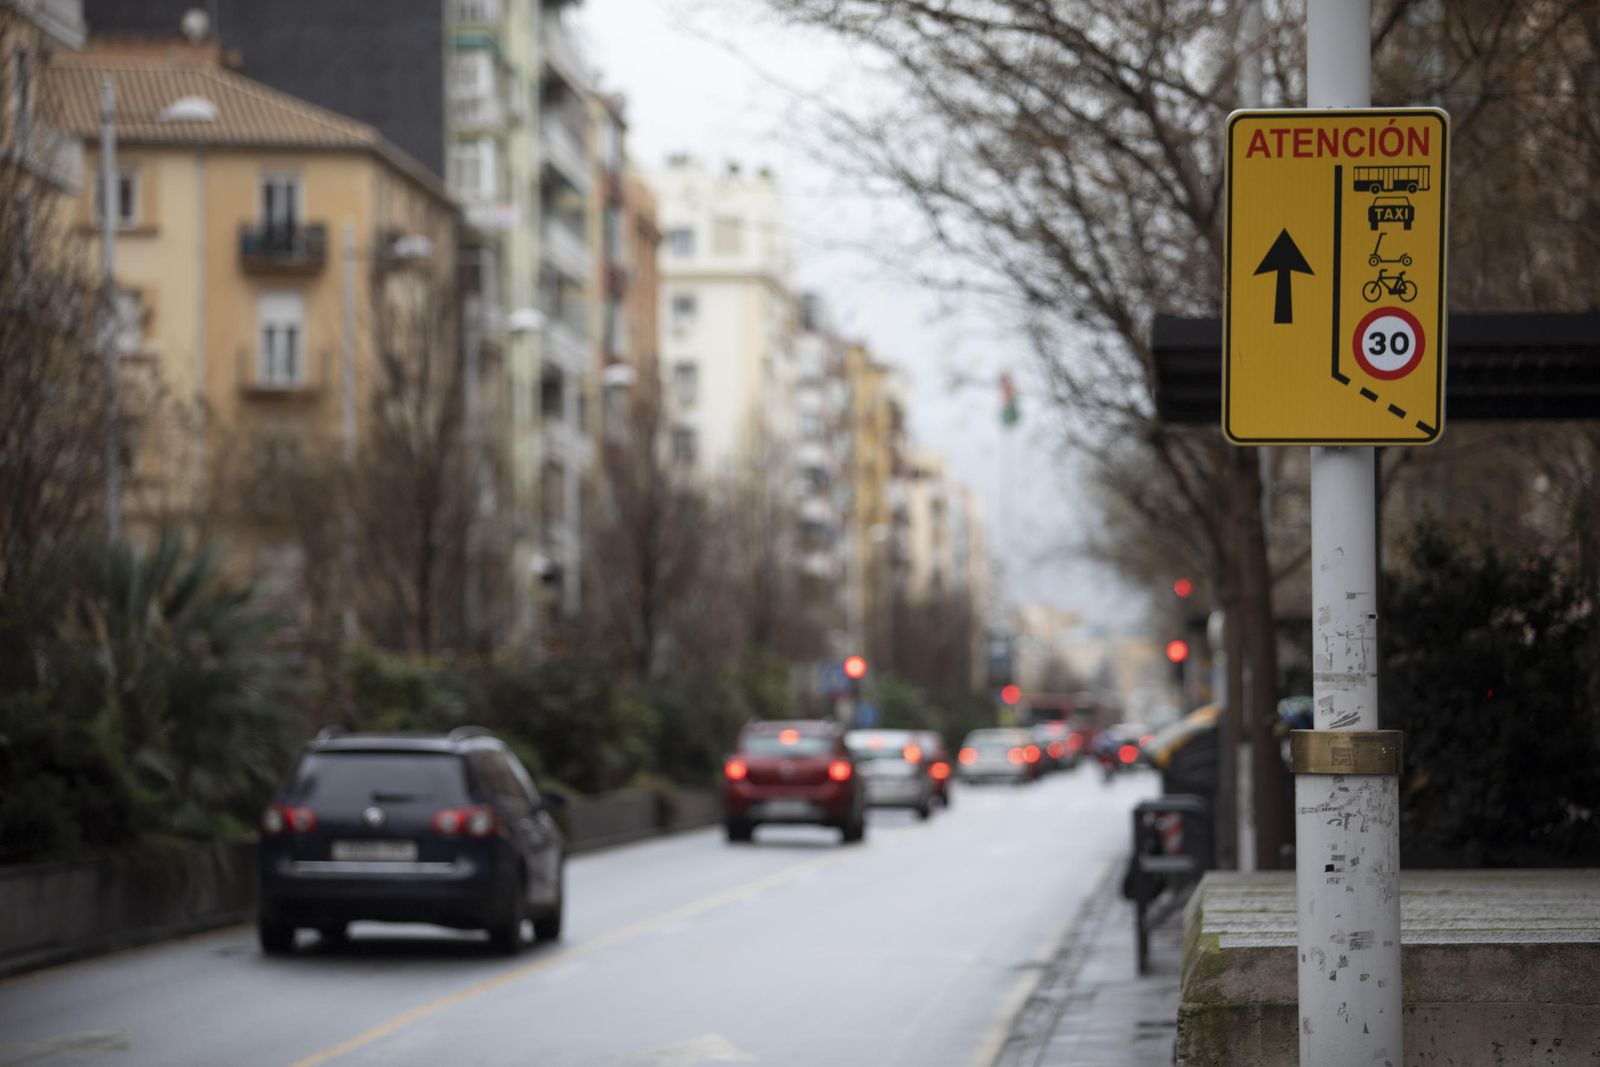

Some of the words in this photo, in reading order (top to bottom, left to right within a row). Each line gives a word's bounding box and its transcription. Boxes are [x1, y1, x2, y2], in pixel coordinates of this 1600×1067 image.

[1246, 119, 1430, 158] ATENCIÓN
[1375, 208, 1409, 221] TAXI
[1368, 332, 1410, 356] 30
